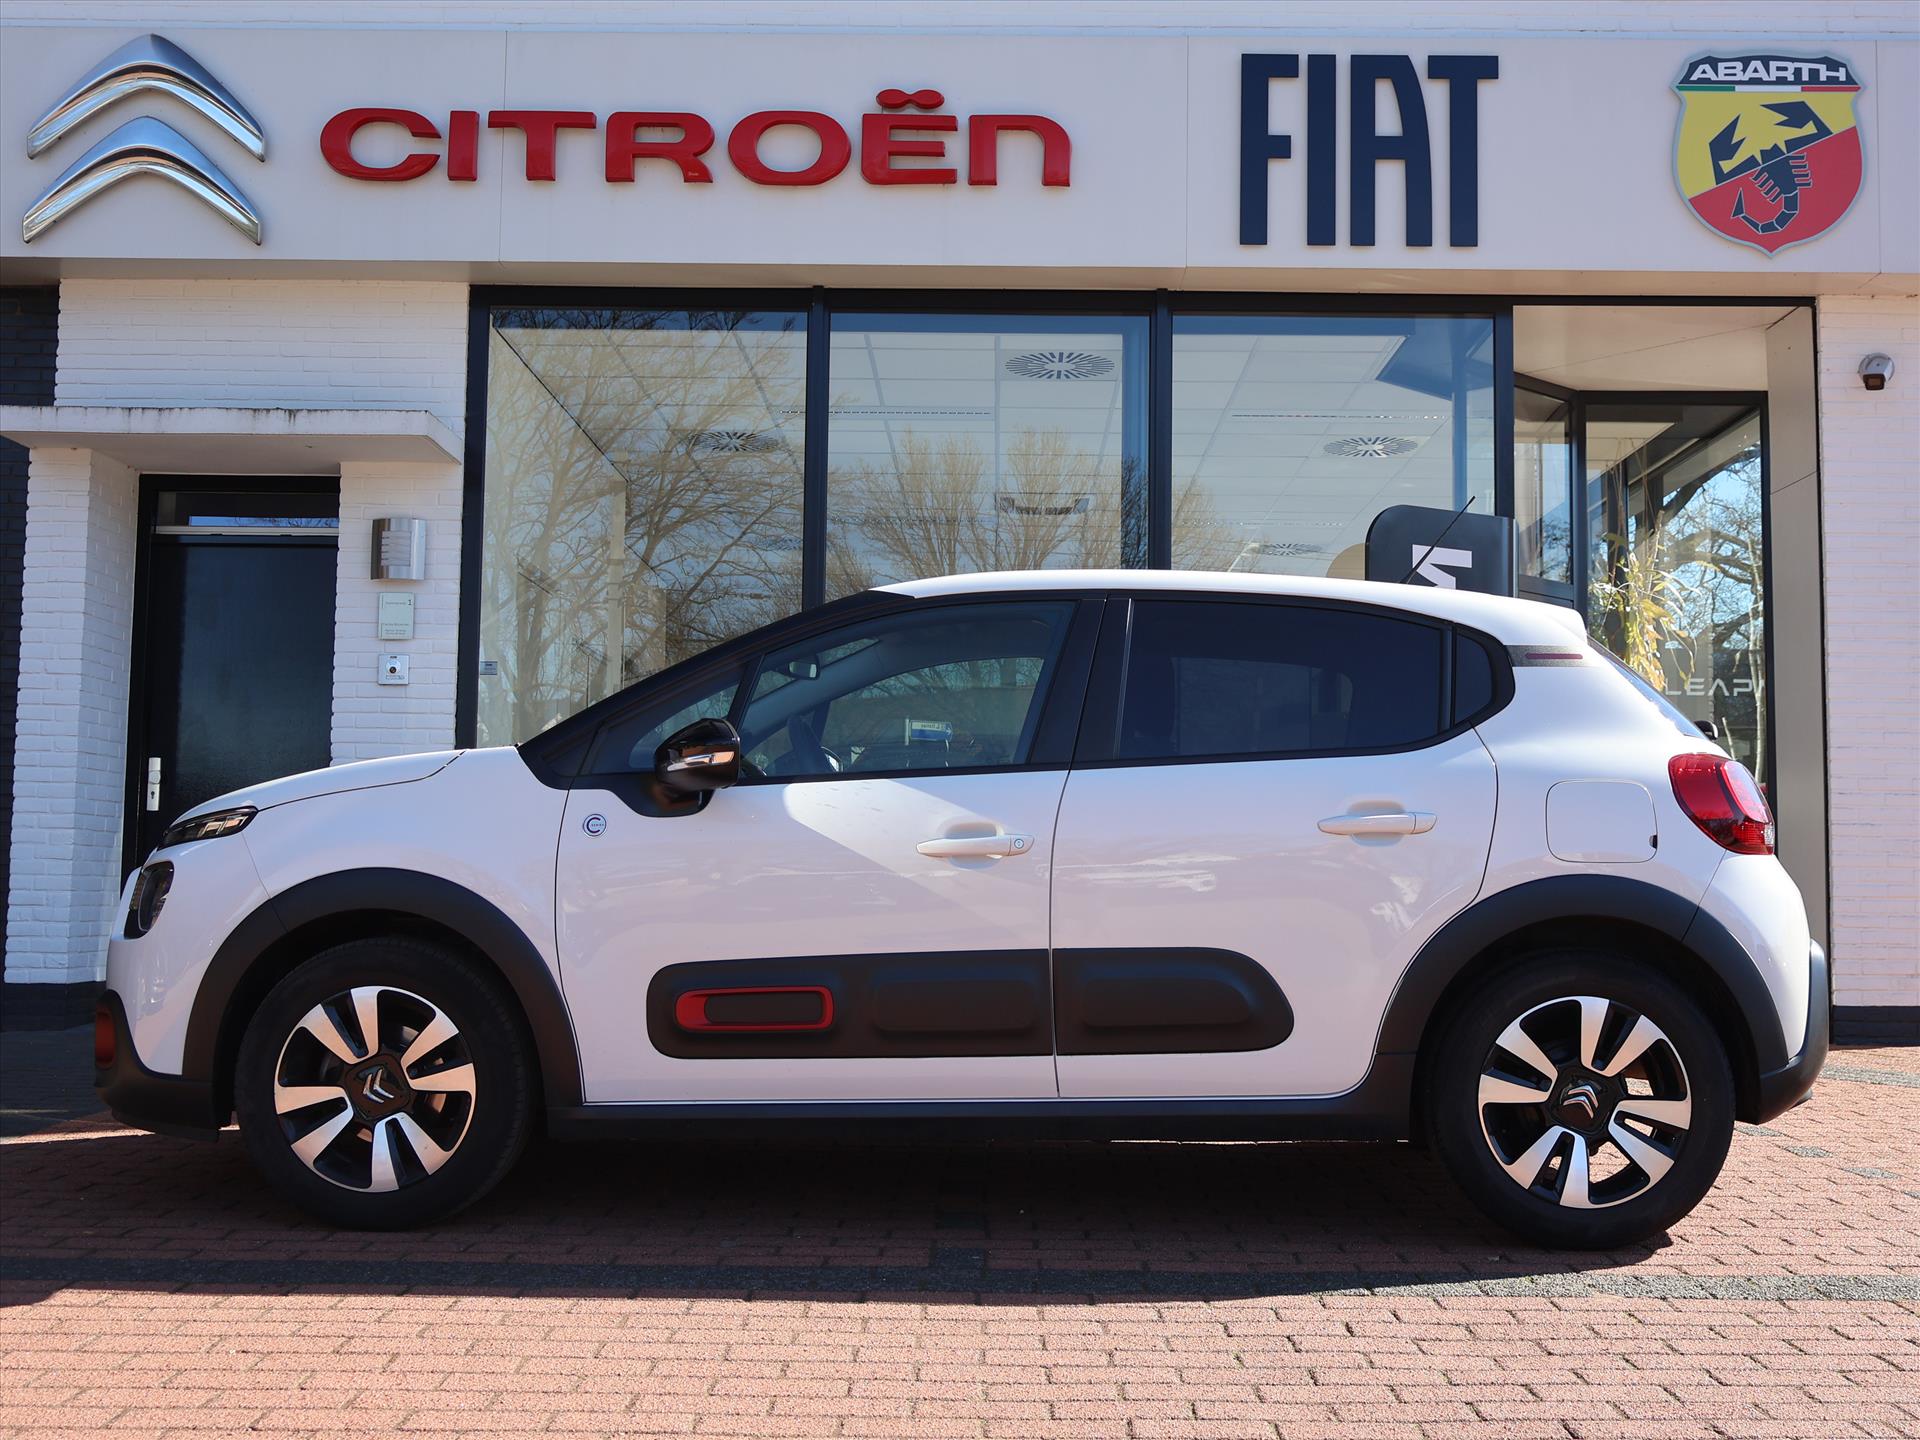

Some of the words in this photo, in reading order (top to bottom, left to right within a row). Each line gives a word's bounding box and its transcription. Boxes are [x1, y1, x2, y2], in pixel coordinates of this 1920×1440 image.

[1689, 60, 1847, 82] ABARTH
[1240, 54, 1498, 247] FIAT
[1665, 678, 1766, 697] LEAP
